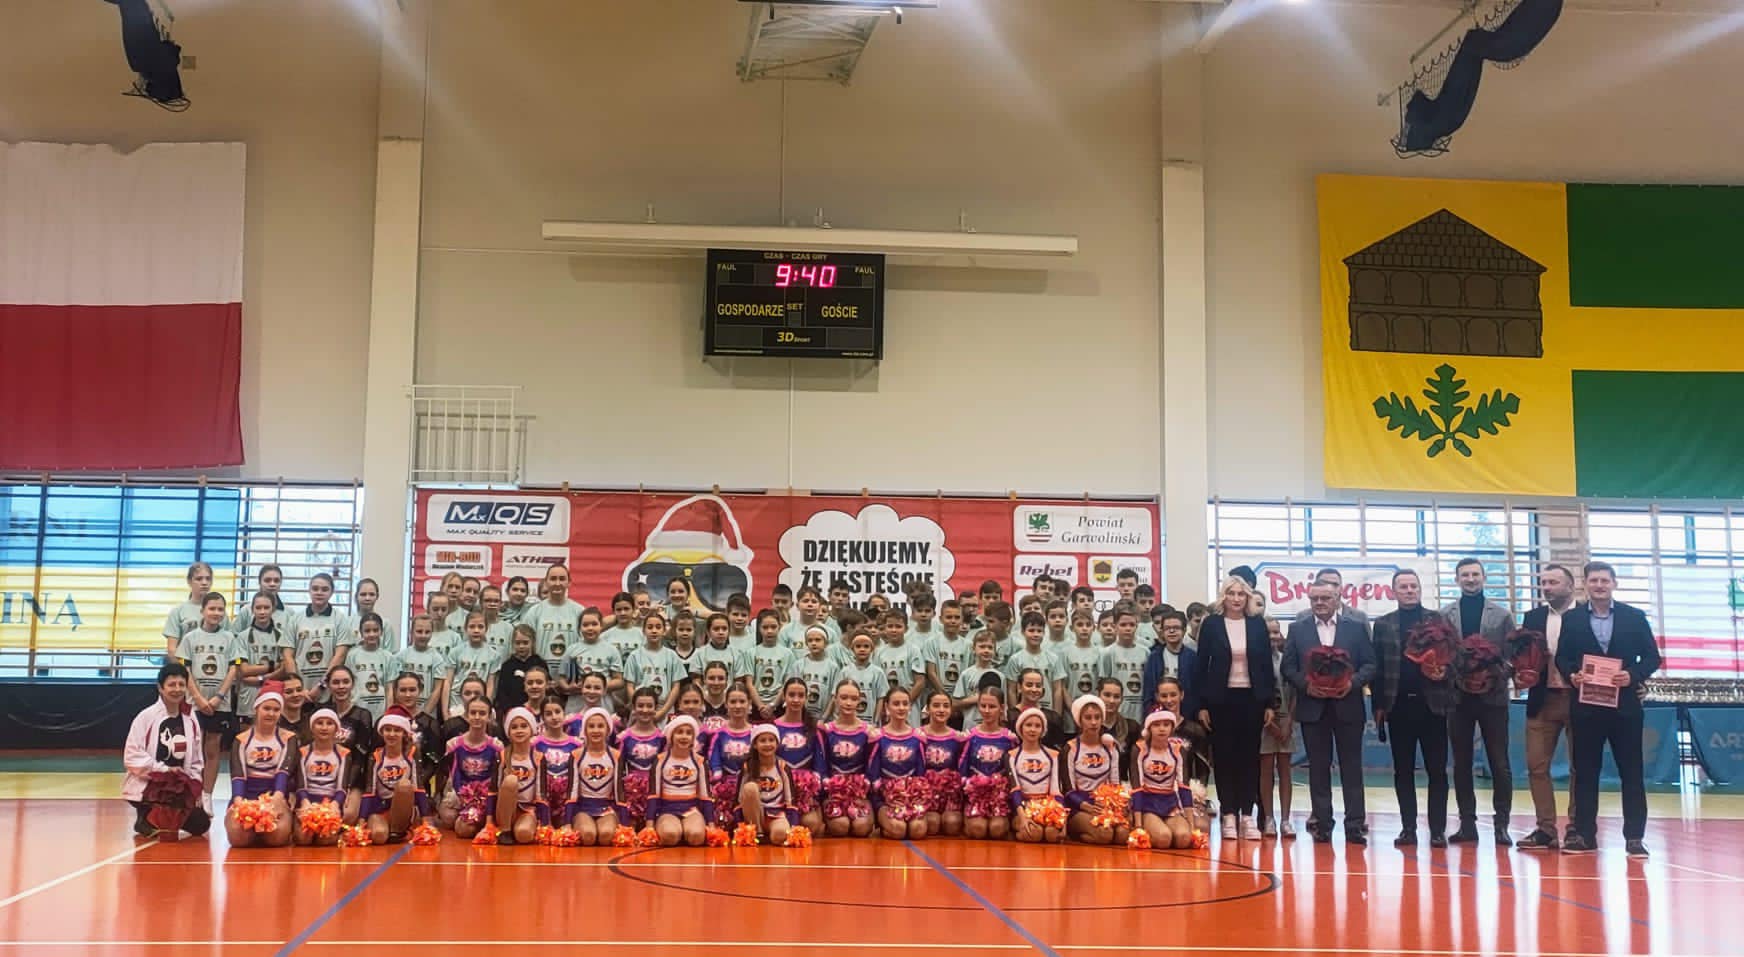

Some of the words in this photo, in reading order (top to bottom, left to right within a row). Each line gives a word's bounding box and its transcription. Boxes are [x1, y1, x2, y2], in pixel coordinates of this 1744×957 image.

[716, 263, 737, 272] FAUL
[854, 266, 875, 274] FAUL
[775, 263, 837, 288] 9:40
[717, 303, 785, 318] GOSPODARZE
[786, 303, 804, 311] SET
[821, 303, 858, 319] GOŚCIE
[1078, 515, 1124, 529] Powiat
[1061, 531, 1142, 545] Garwoliński
[803, 540, 932, 566] DZIĘKUJEMY,
[1019, 563, 1073, 577] Rebel
[801, 566, 822, 592] ŻE
[1265, 571, 1396, 608] Brgen
